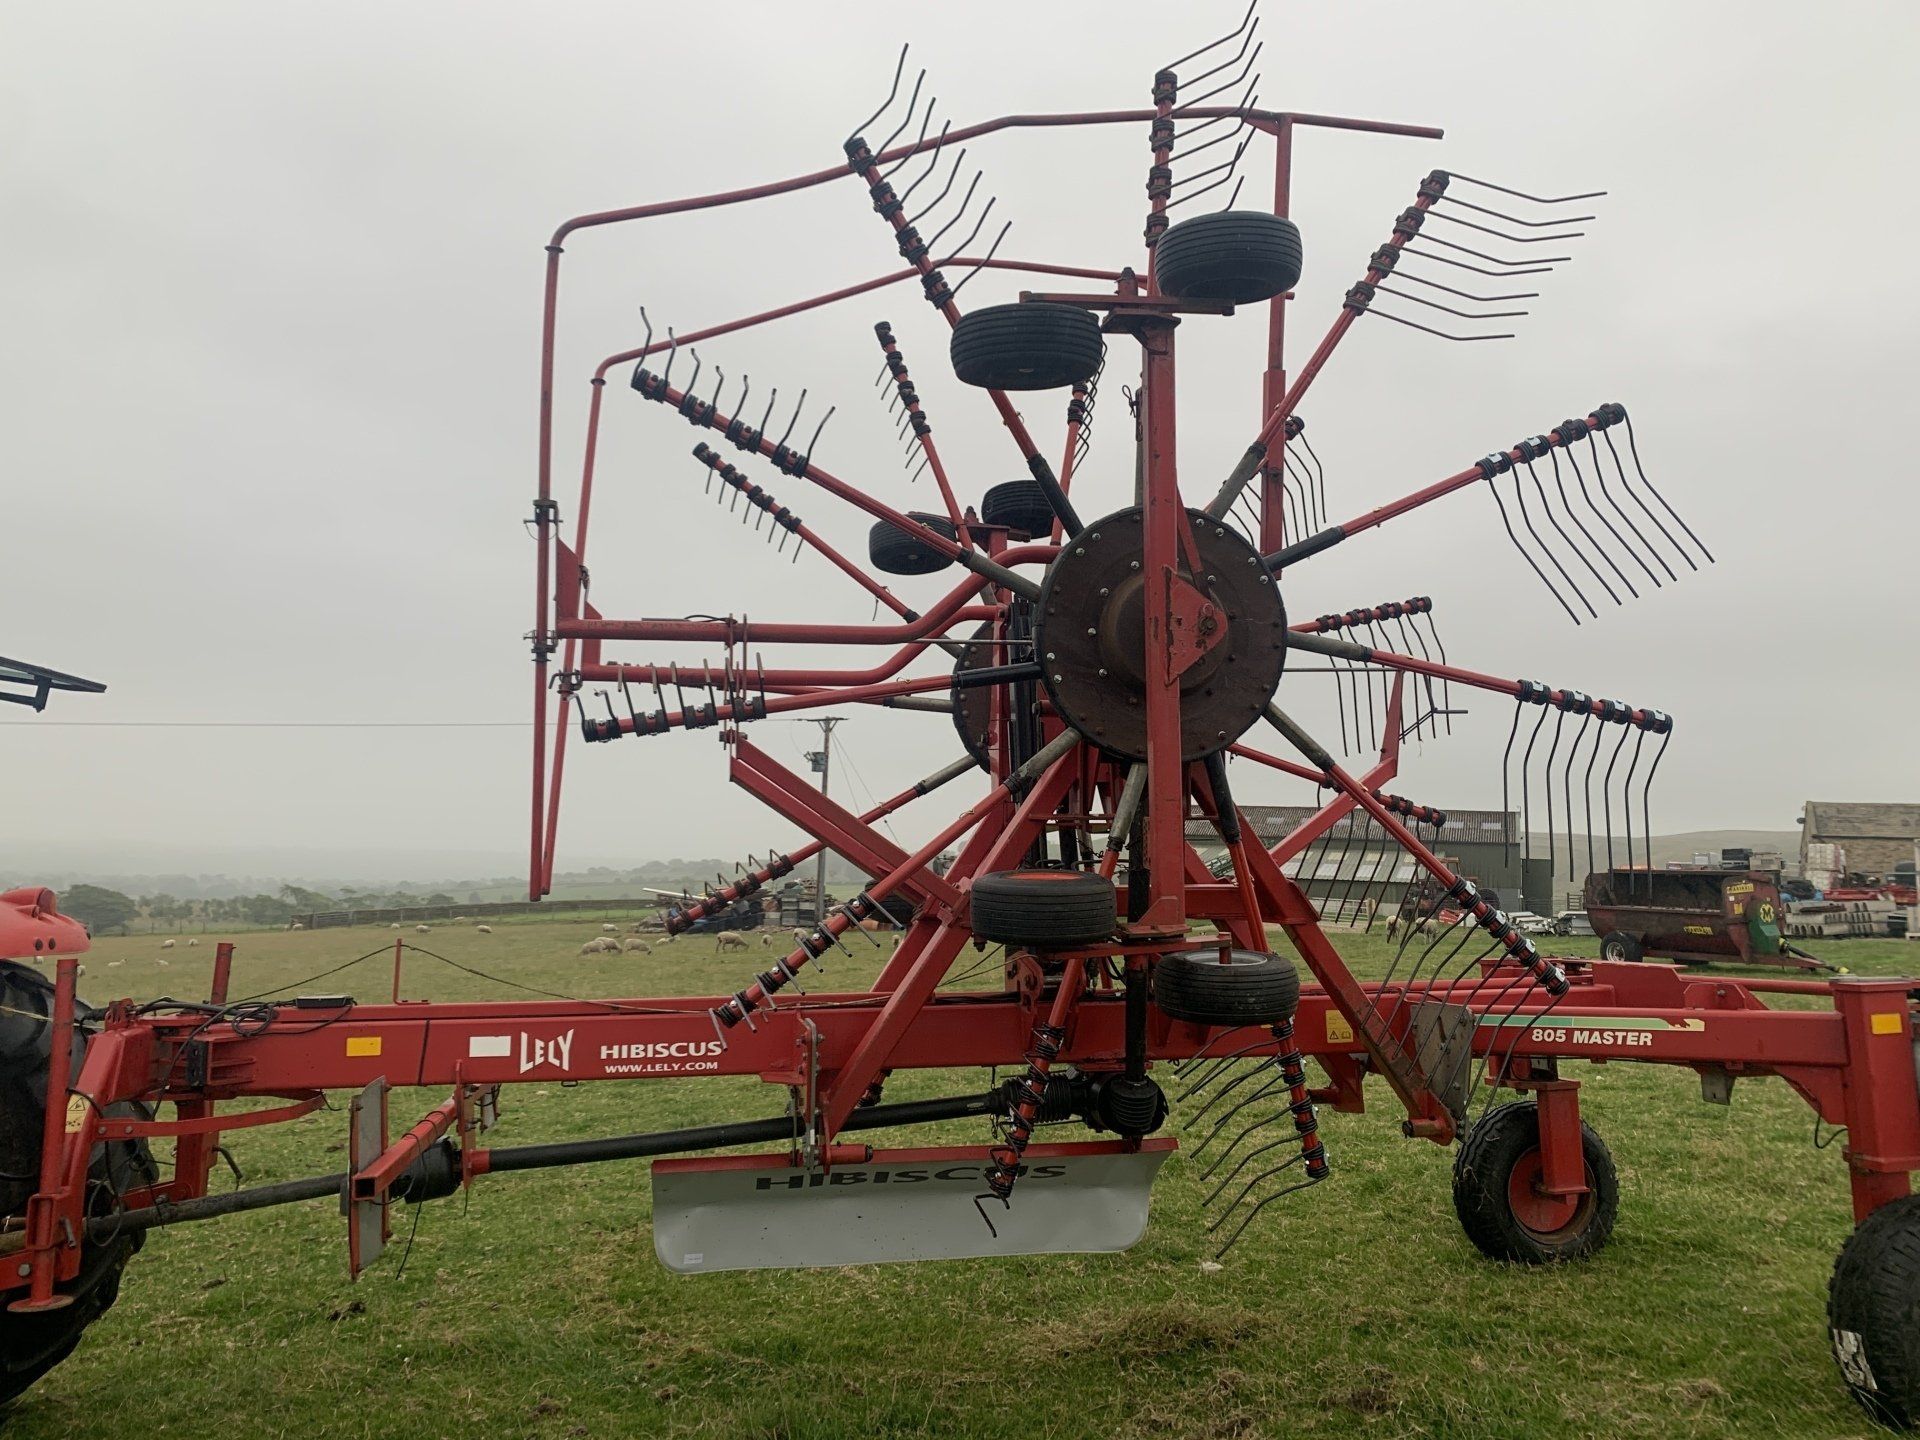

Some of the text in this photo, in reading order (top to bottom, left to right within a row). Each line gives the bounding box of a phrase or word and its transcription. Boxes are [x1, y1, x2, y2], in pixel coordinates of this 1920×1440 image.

[1531, 1029, 1653, 1046] 805 MASTER
[520, 1028, 574, 1074] LELY
[600, 1041, 722, 1060] HIBISCUS
[605, 1061, 718, 1073] WWW.LELY.COM
